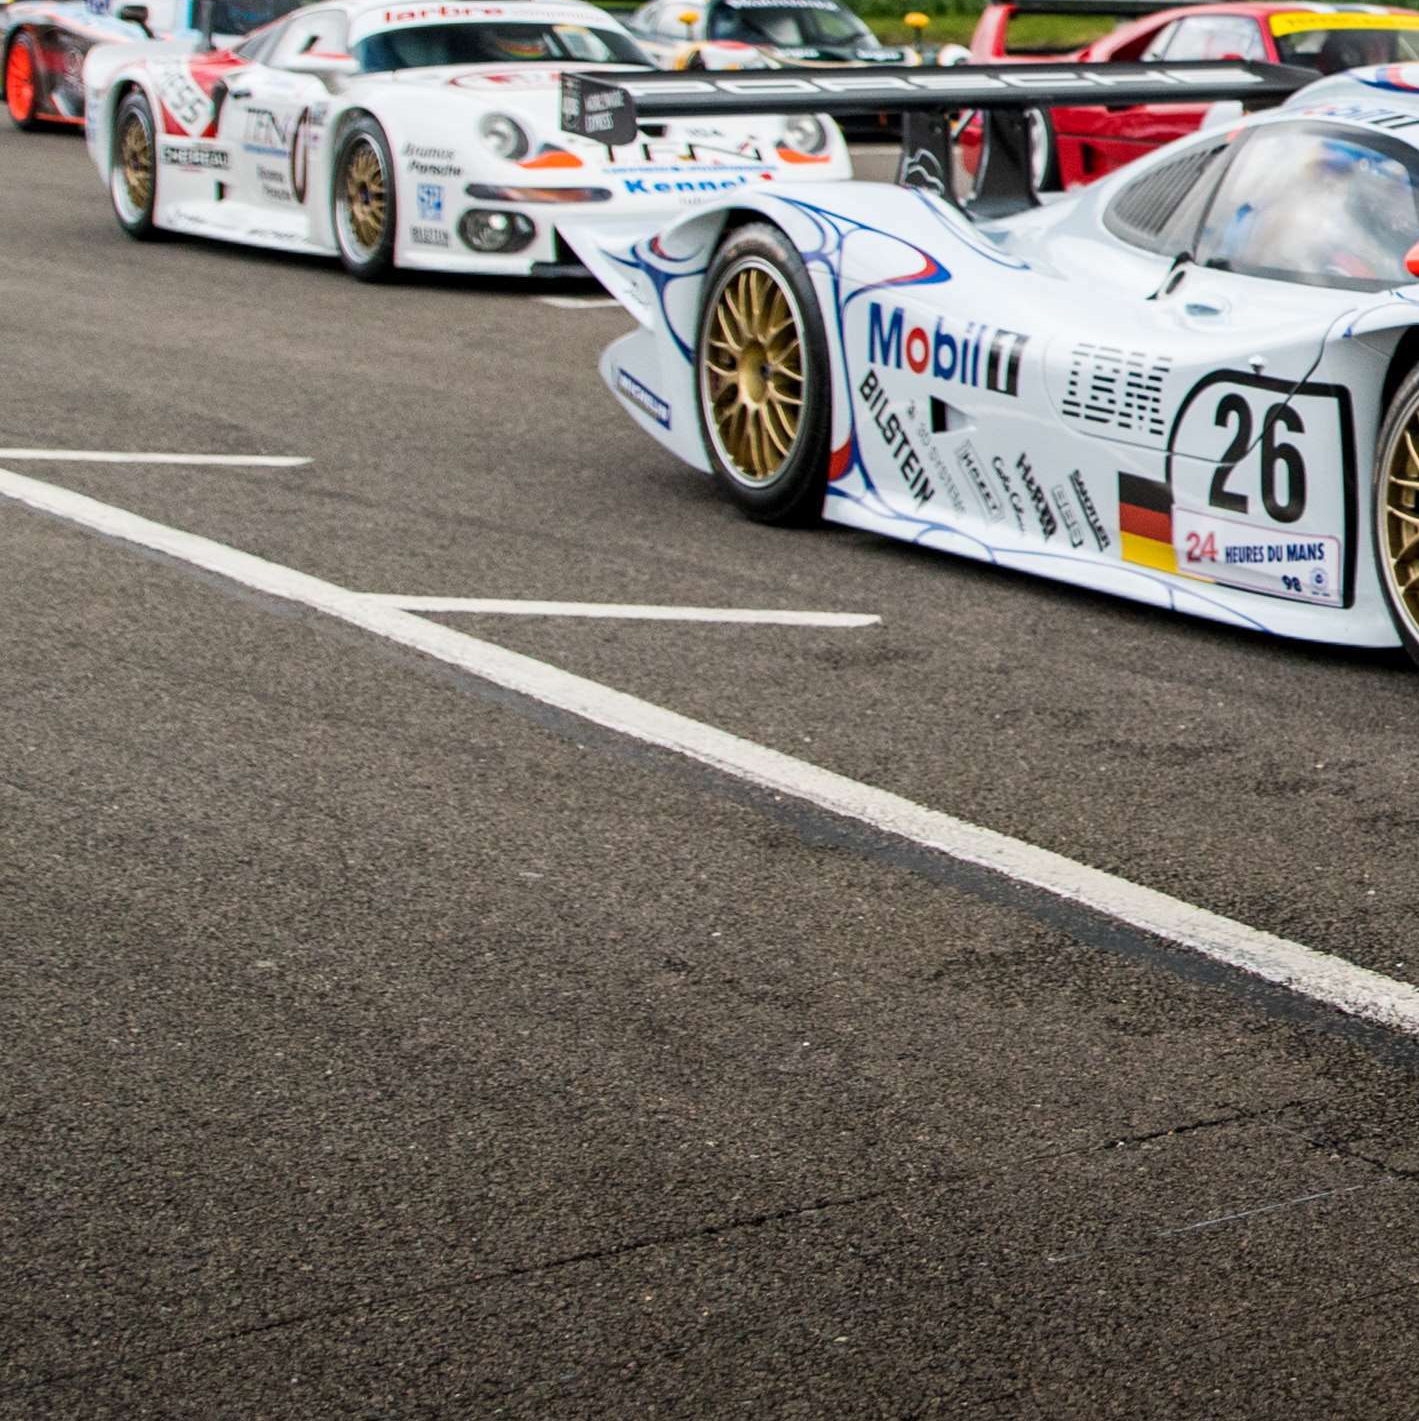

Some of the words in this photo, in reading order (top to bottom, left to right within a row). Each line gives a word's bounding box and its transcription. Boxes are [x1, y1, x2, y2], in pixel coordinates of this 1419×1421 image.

[619, 68, 1264, 97] PORSCHE
[868, 302, 987, 388] Mobil
[1062, 342, 1173, 436] IBM
[859, 369, 936, 507] BILSTEIN
[1209, 392, 1307, 524] 26
[1184, 531, 1219, 564] 24
[1225, 545, 1265, 565] HEURES
[1267, 545, 1283, 564] DU
[1286, 542, 1325, 563] MANS
[1281, 574, 1303, 593] 98
